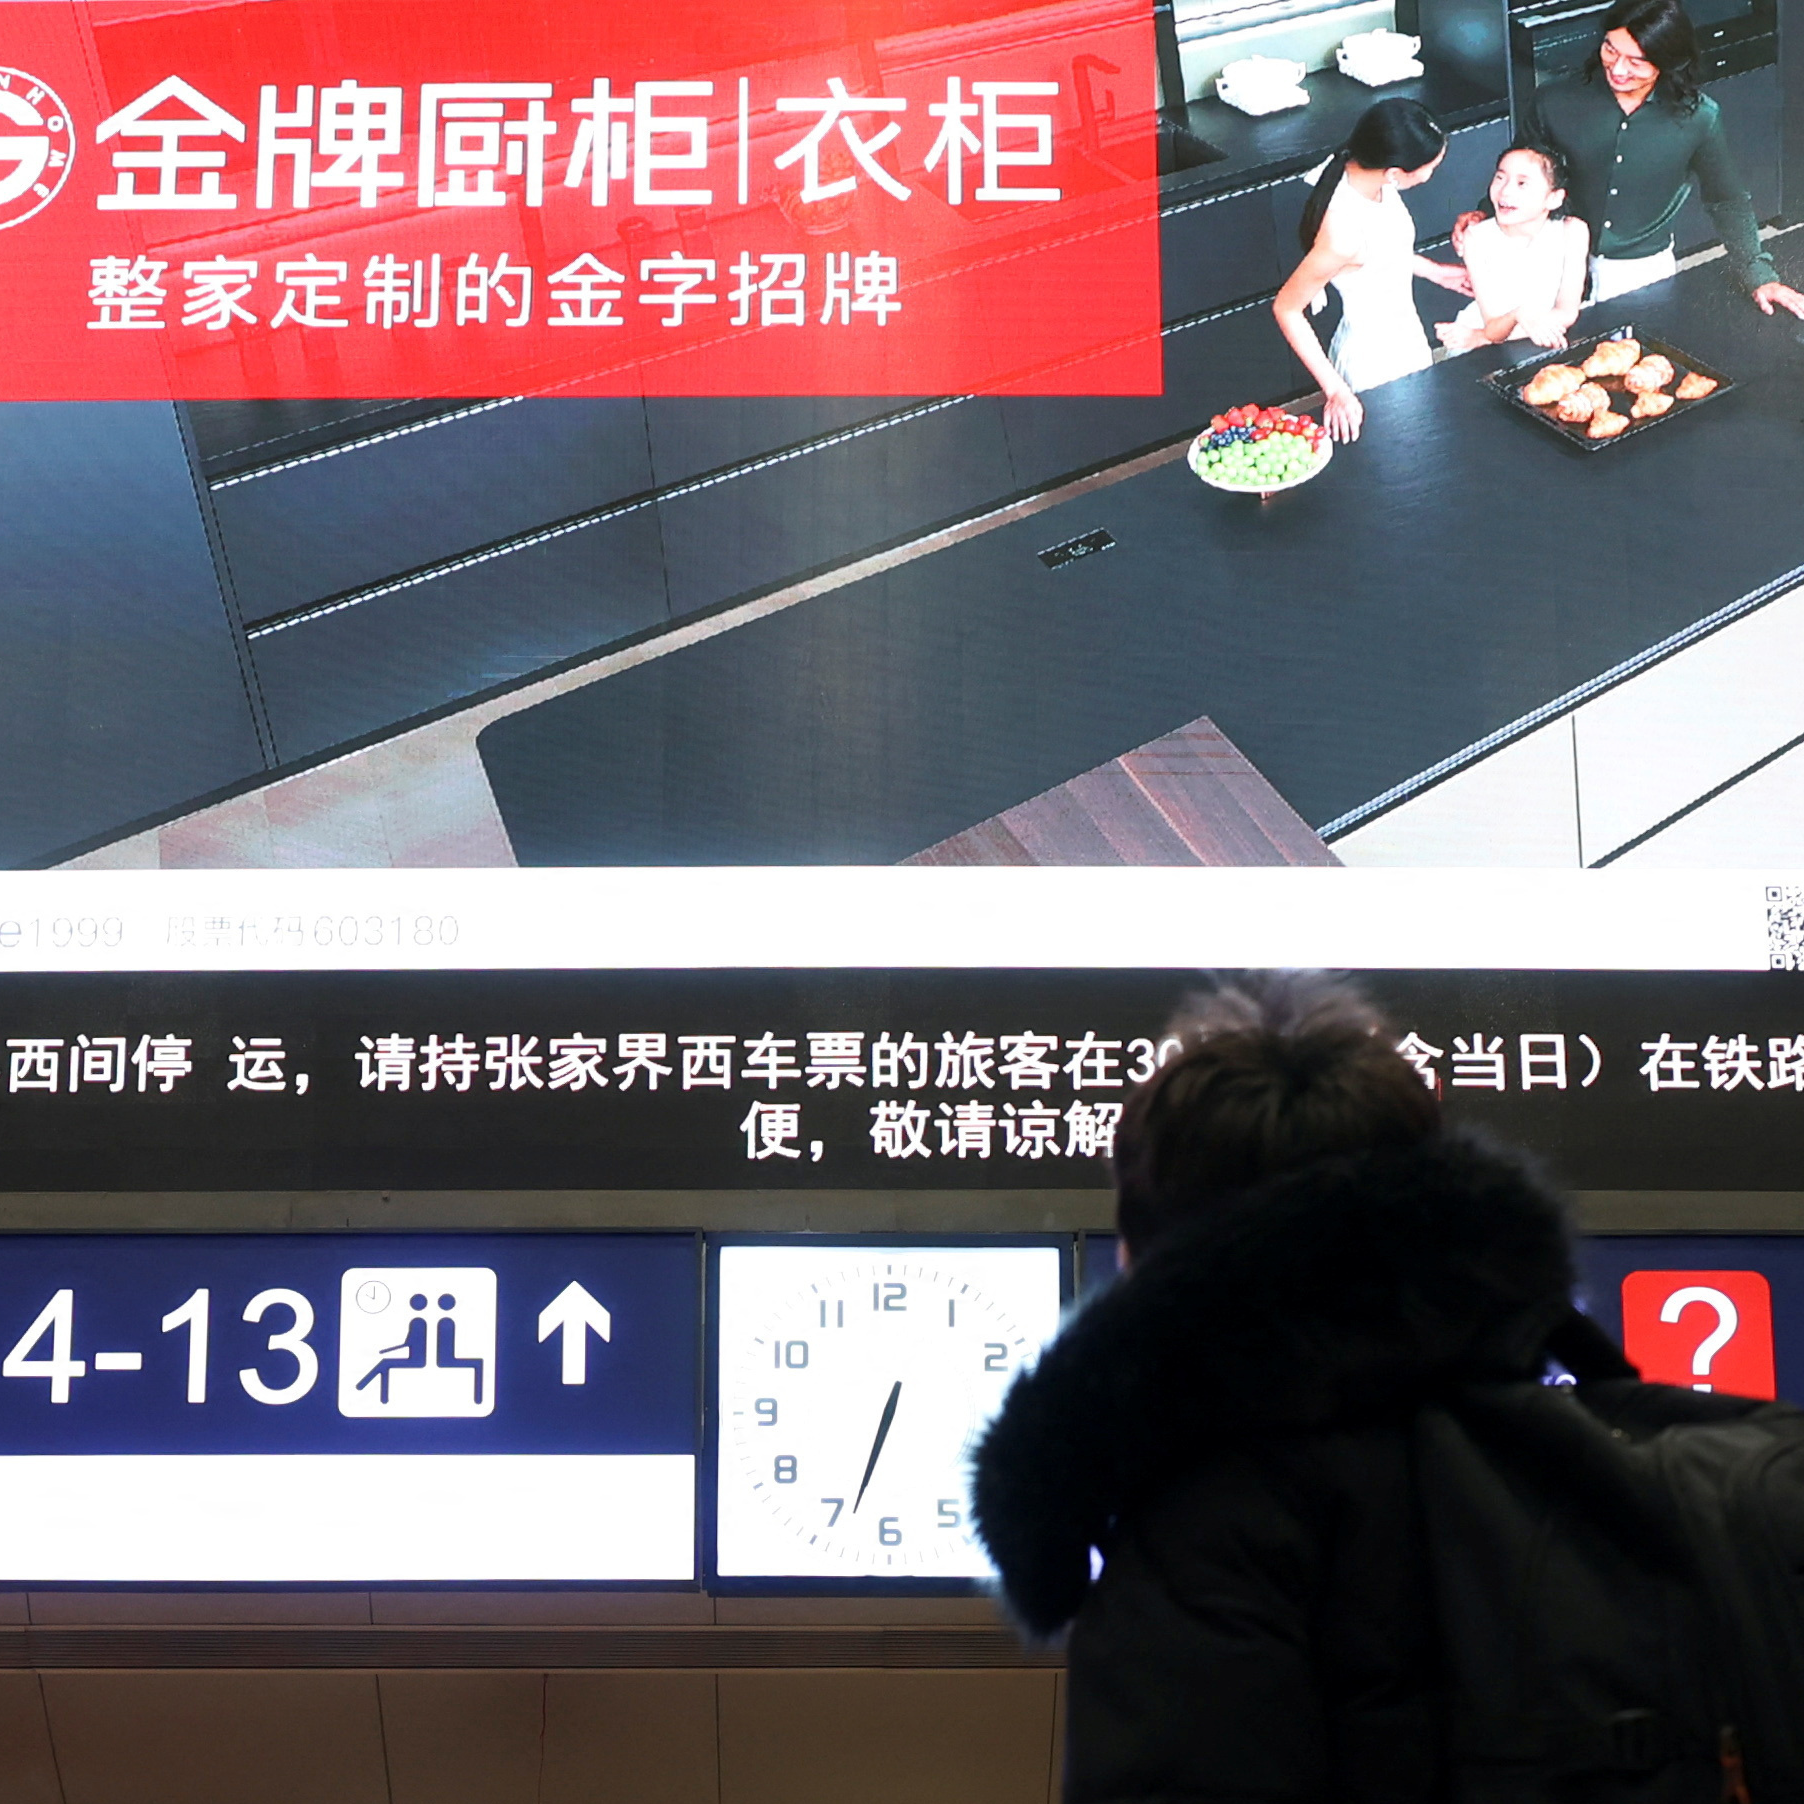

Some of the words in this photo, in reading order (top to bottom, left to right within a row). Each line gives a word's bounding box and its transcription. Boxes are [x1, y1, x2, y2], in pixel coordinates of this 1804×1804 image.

[86, 251, 904, 331] 整家定制的金字招牌
[873, 1283, 907, 1311] 12
[819, 1299, 844, 1328] 11
[948, 1299, 955, 1327] 1
[3, 1289, 317, 1404] 4-13
[774, 1340, 809, 1368] 10
[984, 1343, 1008, 1372] 2
[754, 1398, 778, 1427] 9
[773, 1455, 797, 1484] 8
[820, 1498, 844, 1527] 7
[937, 1499, 960, 1528] 5
[878, 1517, 902, 1546] 6
